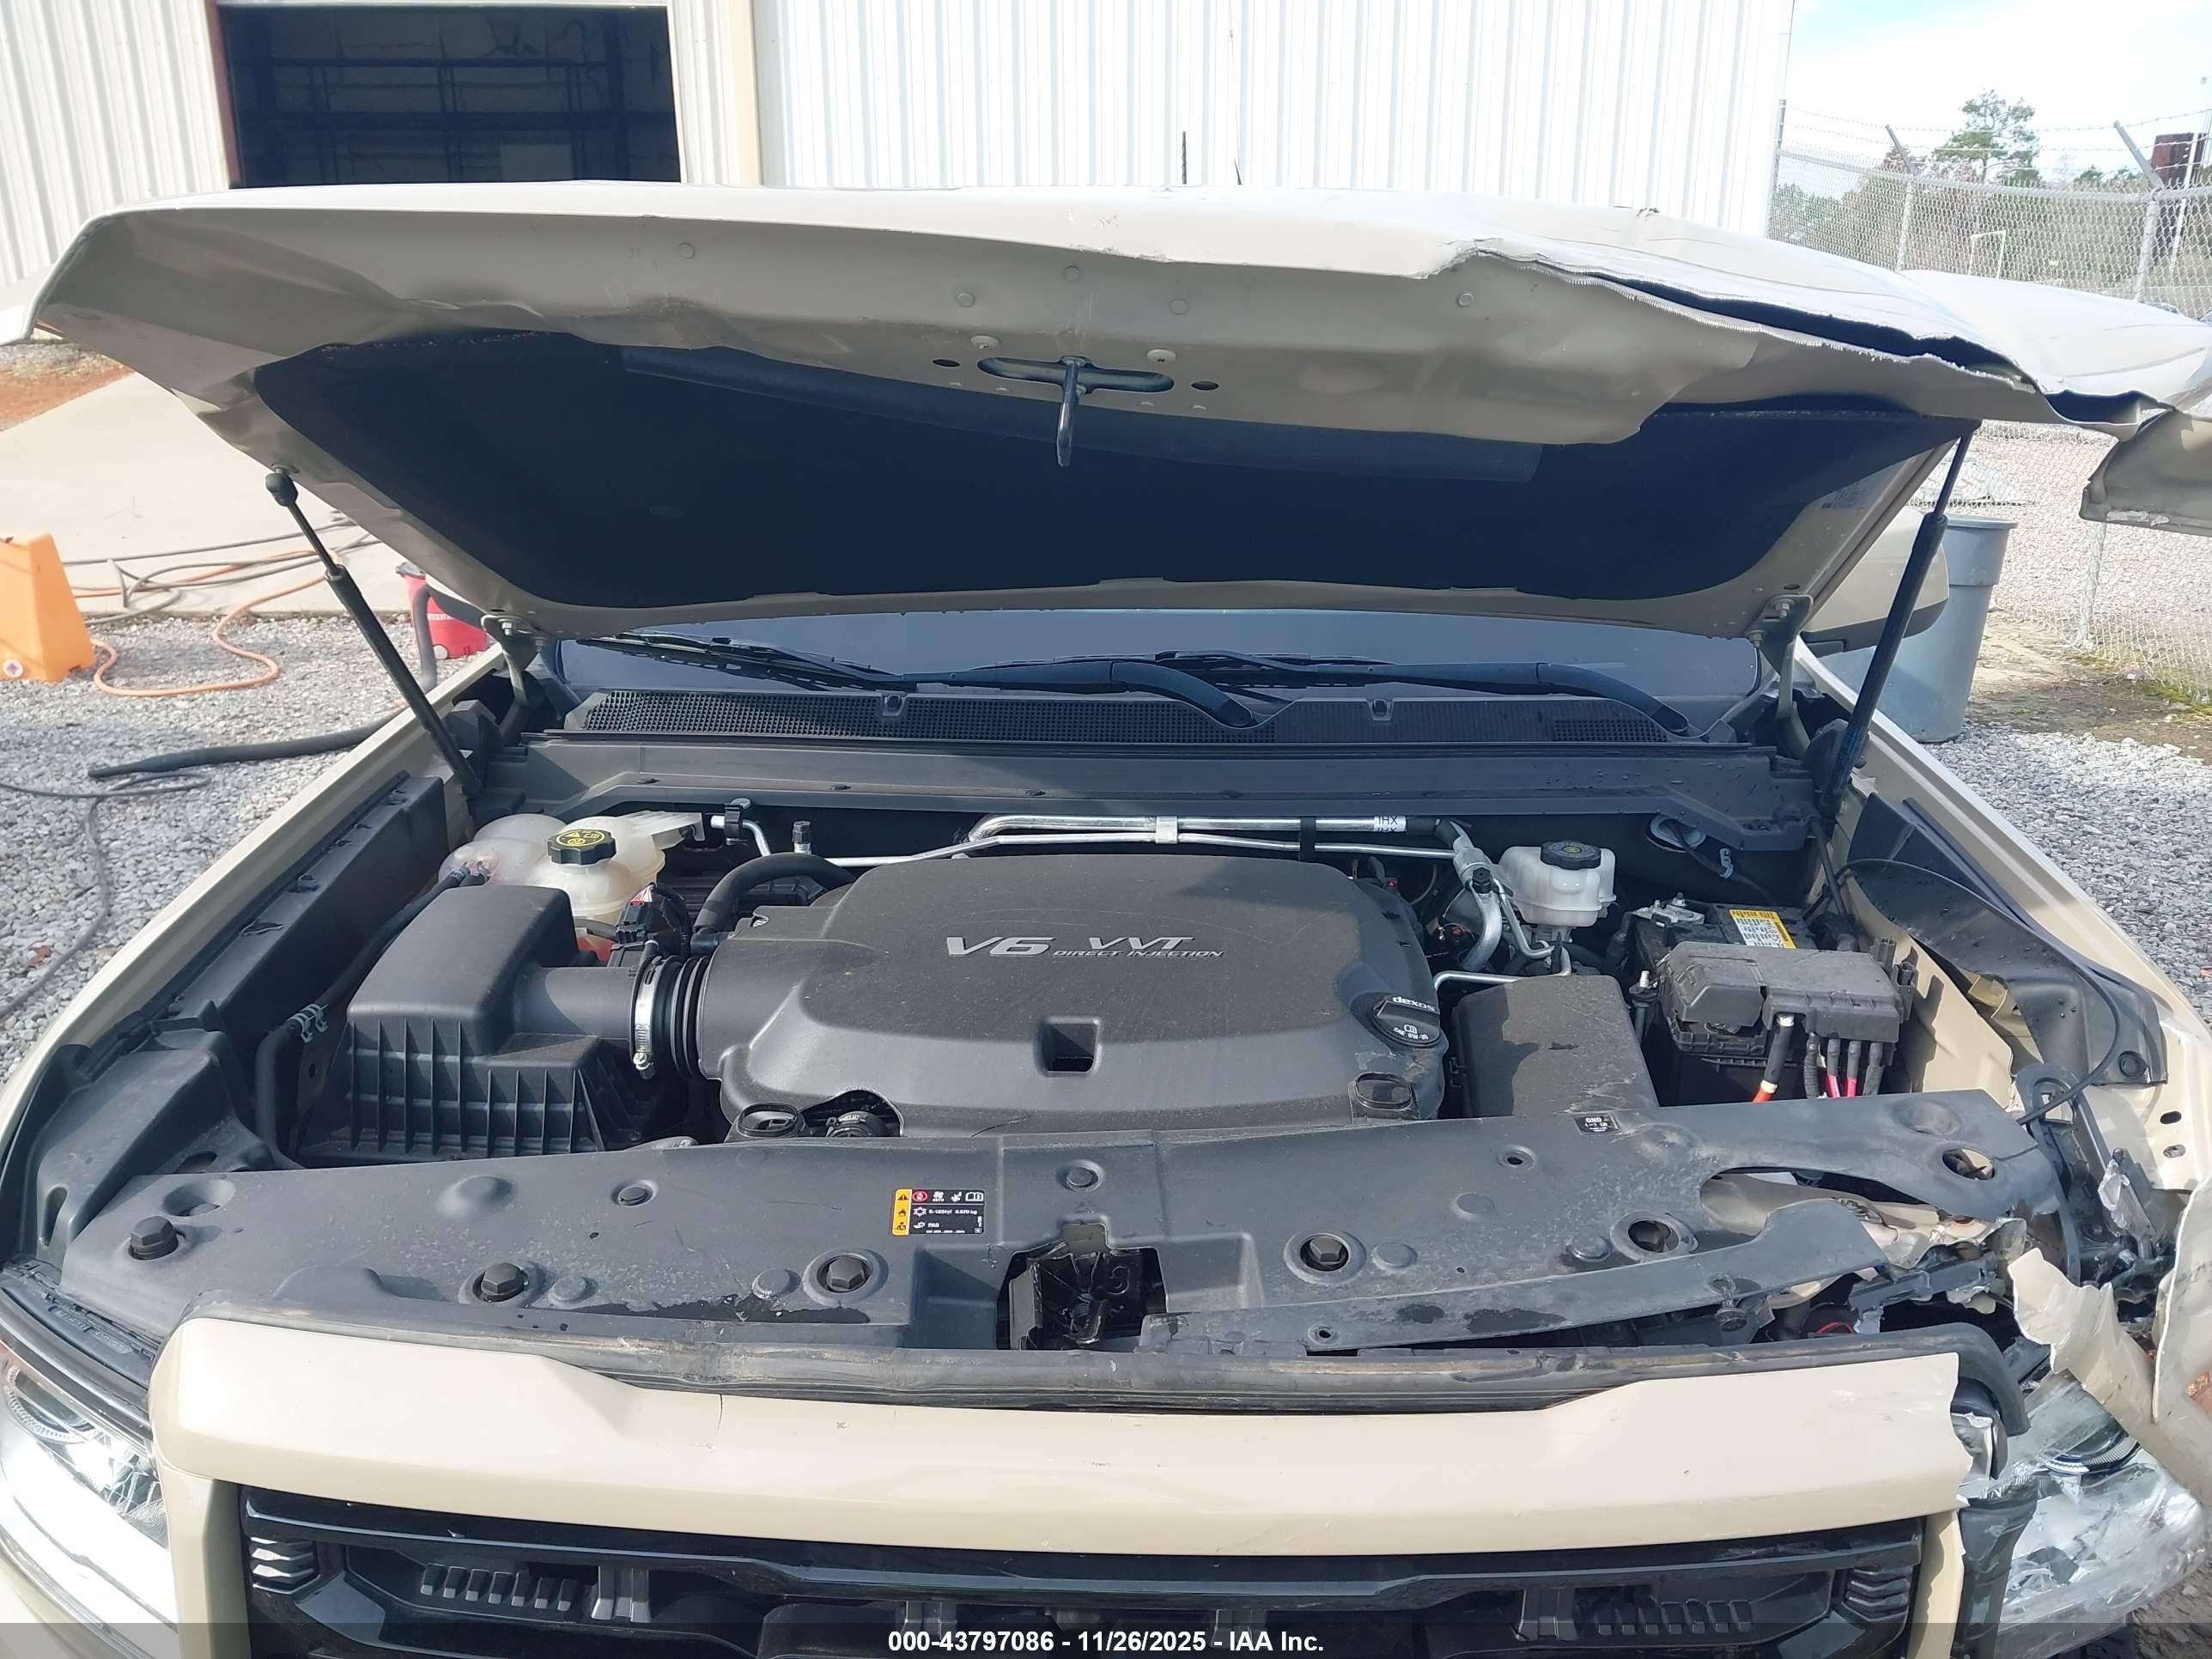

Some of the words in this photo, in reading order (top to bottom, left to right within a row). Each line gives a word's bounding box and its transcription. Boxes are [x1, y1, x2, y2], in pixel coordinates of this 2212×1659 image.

[946, 936, 1056, 956] V6
[1088, 937, 1195, 950] VVT
[1392, 996, 1436, 1012] dexos
